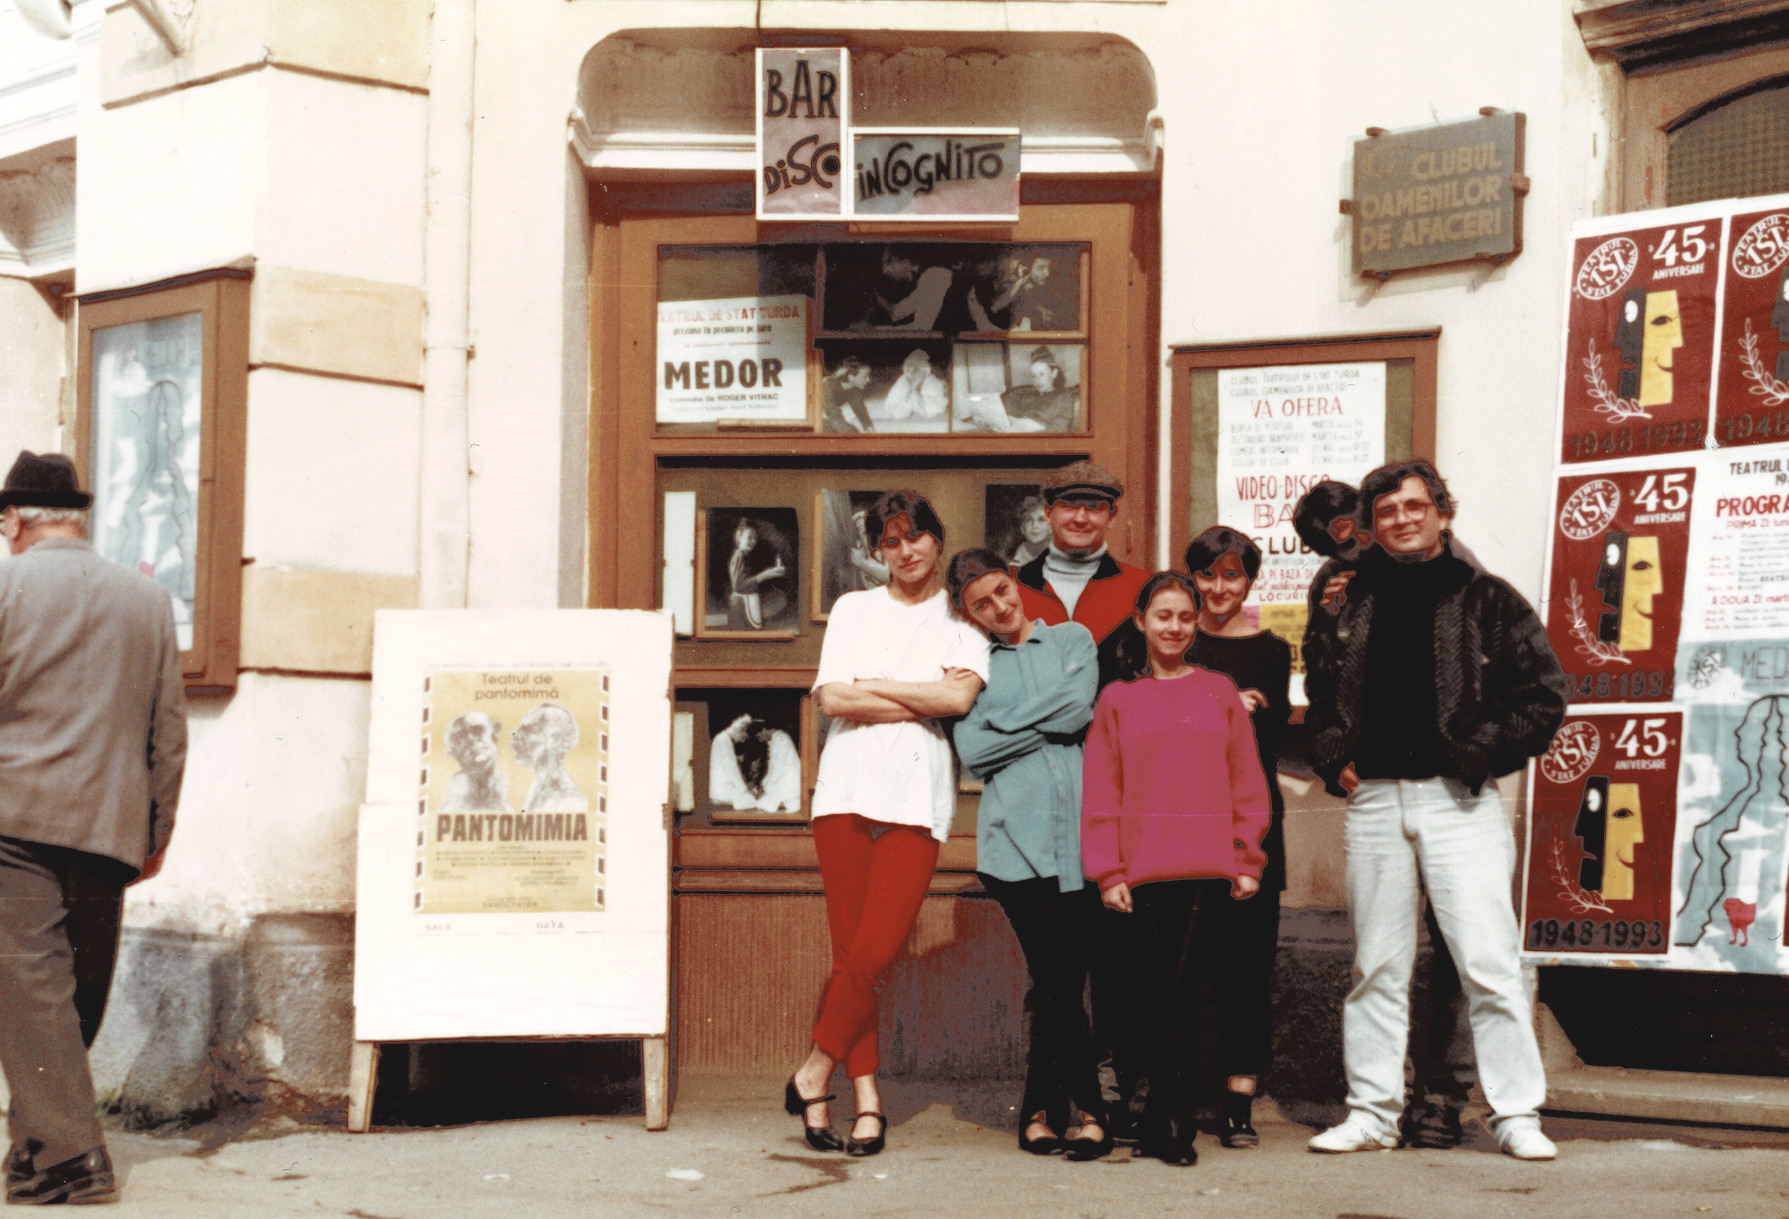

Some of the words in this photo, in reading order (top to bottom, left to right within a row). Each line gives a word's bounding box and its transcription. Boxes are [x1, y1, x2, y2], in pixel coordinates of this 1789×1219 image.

[766, 60, 839, 118] BAR
[1412, 141, 1502, 180] CLUBUL
[1360, 174, 1503, 222] OAMENILOR
[1360, 222, 1392, 254] DE
[1400, 207, 1500, 247] AFACERI
[1652, 225, 1706, 267] 45
[1652, 263, 1705, 280] ANIVERSARE
[1742, 264, 1770, 276] STAT
[1585, 285, 1613, 297] STAT
[727, 307, 757, 320] STAT
[760, 305, 800, 320] TURDA
[664, 357, 783, 390] MEDOR
[717, 393, 747, 401] ROGER
[750, 392, 779, 401] VITRAC
[1281, 396, 1343, 417] OFERA
[1730, 459, 1782, 476] TEATRUL
[1236, 473, 1331, 501] VIDEO-DISC
[1634, 473, 1688, 512] 45
[1254, 503, 1294, 529] BA
[1633, 511, 1686, 525] ANIVERSARE
[1568, 526, 1597, 537] STAT
[482, 673, 529, 686] Teatrul
[533, 673, 553, 685] de
[1614, 718, 1668, 757] 45
[1614, 758, 1666, 770] ANIVERSARE
[1549, 769, 1575, 781] STAT
[436, 813, 588, 842] PANTOMIMIA
